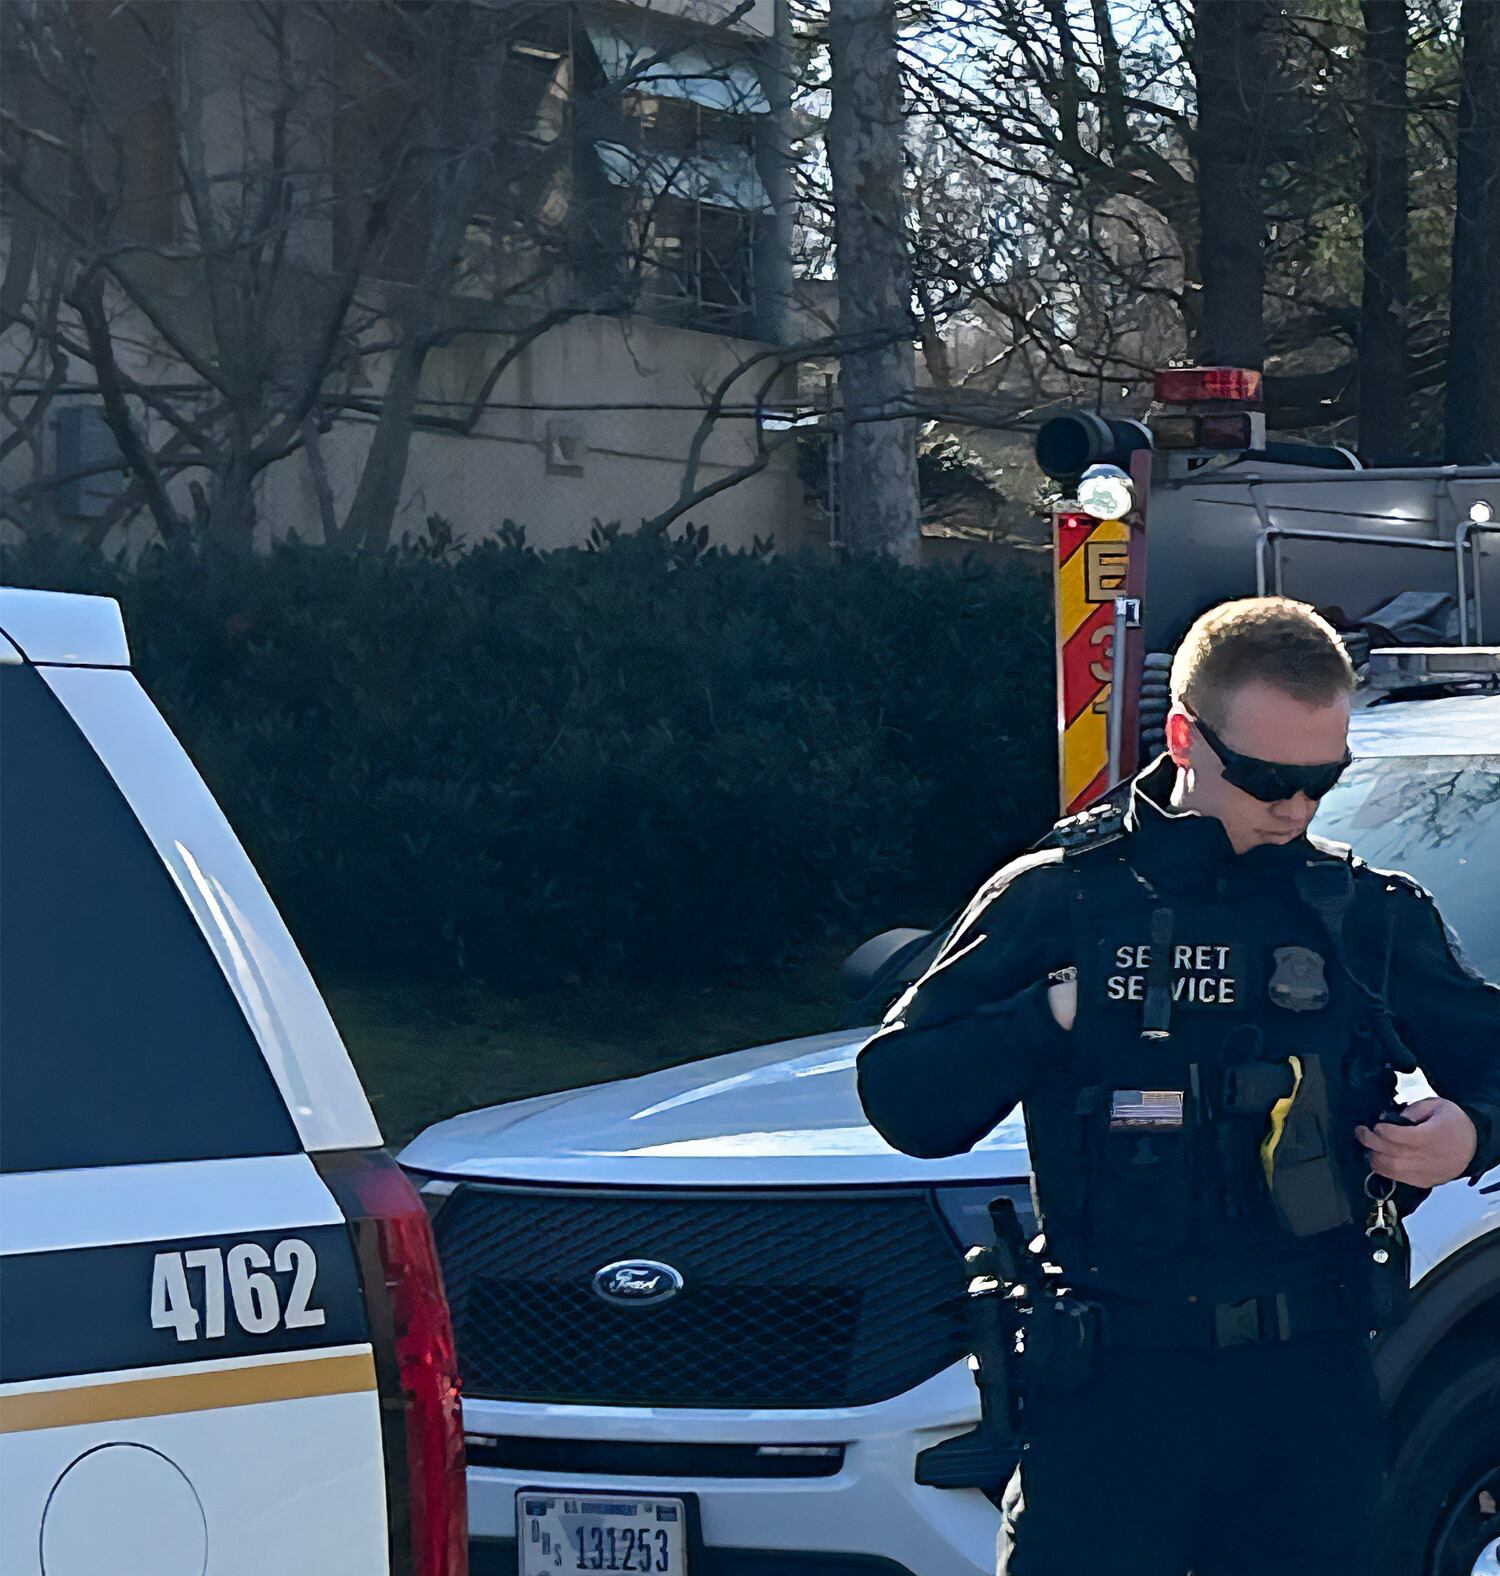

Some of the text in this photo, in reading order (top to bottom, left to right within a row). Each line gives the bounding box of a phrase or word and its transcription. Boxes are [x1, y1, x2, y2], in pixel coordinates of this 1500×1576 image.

[1115, 945, 1230, 971] SERET
[1107, 975, 1236, 1003] SEVICE
[150, 1239, 326, 1342] 4762
[576, 1525, 669, 1572] 131253
